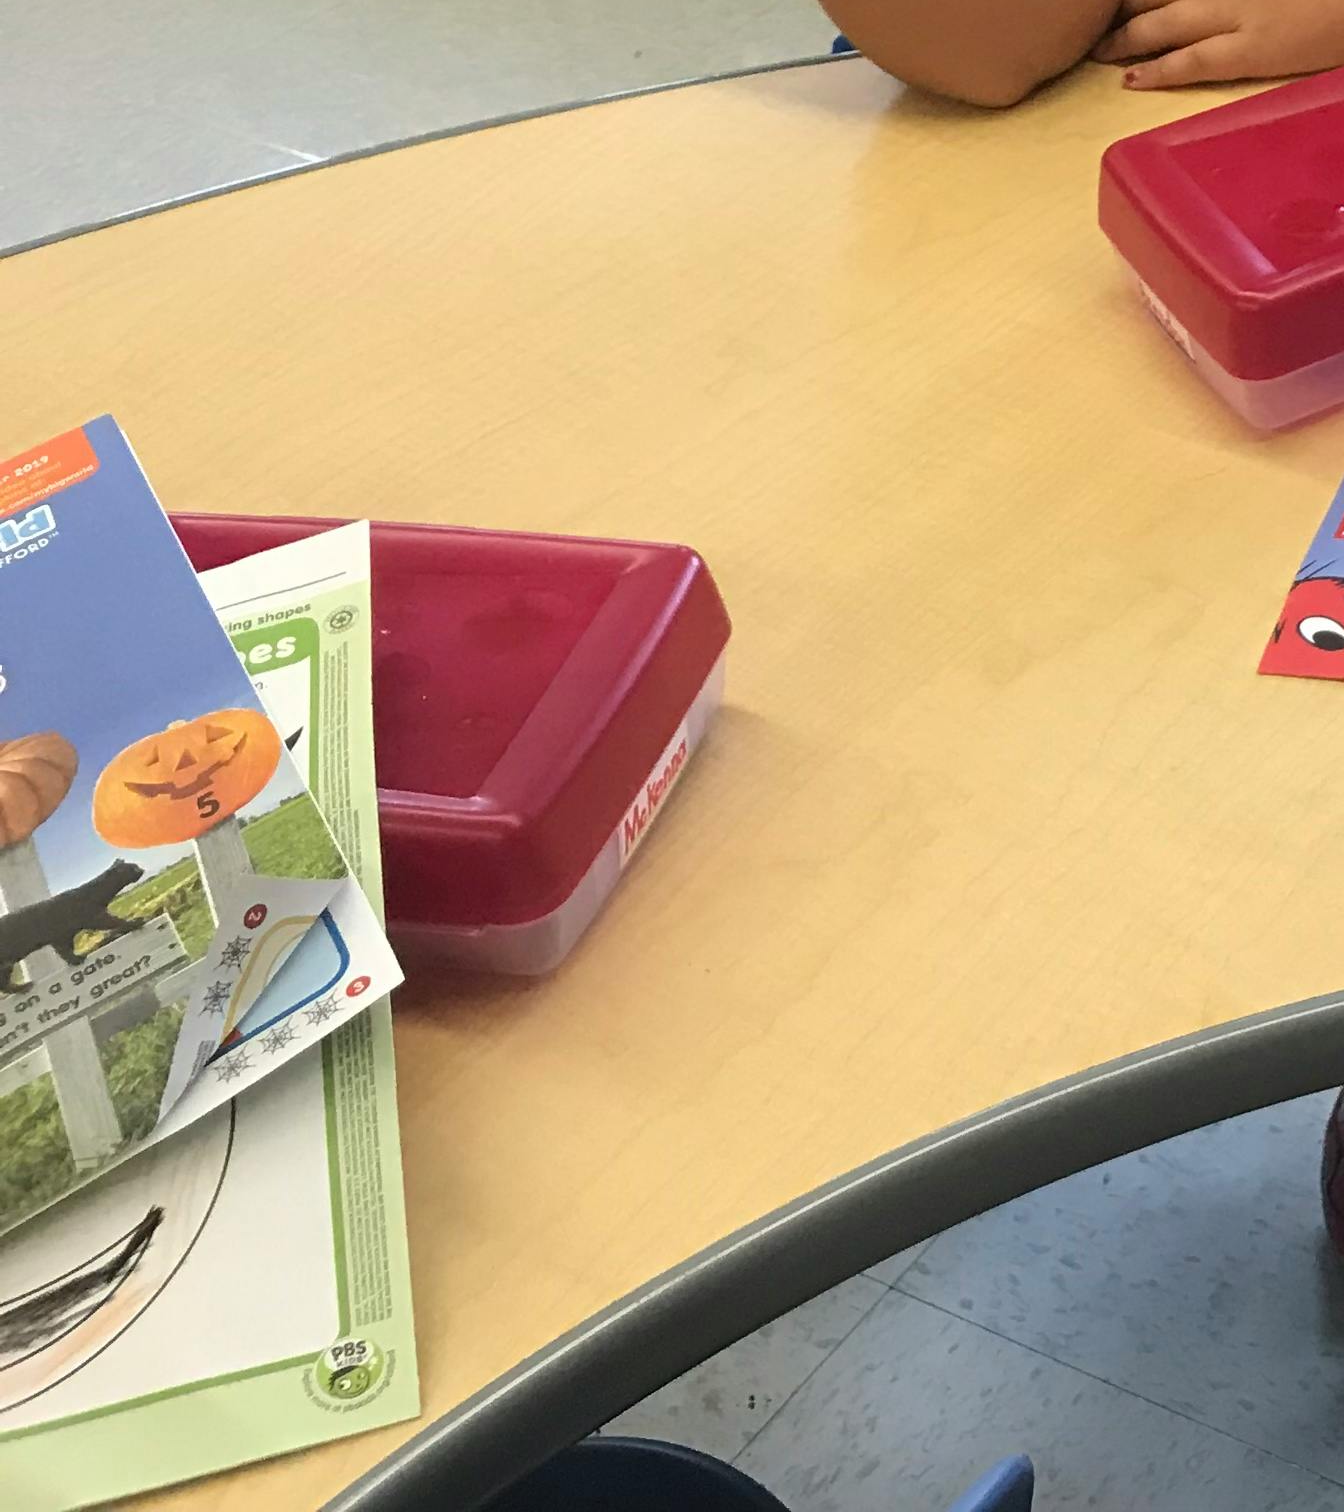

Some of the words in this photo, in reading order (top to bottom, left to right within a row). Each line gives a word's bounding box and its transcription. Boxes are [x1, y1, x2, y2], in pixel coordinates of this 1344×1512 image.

[14, 455, 49, 477] 2019
[257, 603, 312, 626] shapes
[196, 791, 220, 819] 5
[15, 994, 41, 1014] on
[49, 982, 63, 996] a
[70, 952, 122, 986] gate.
[37, 995, 81, 1024] they
[90, 954, 152, 1000] great?
[331, 1340, 367, 1362] PBS
